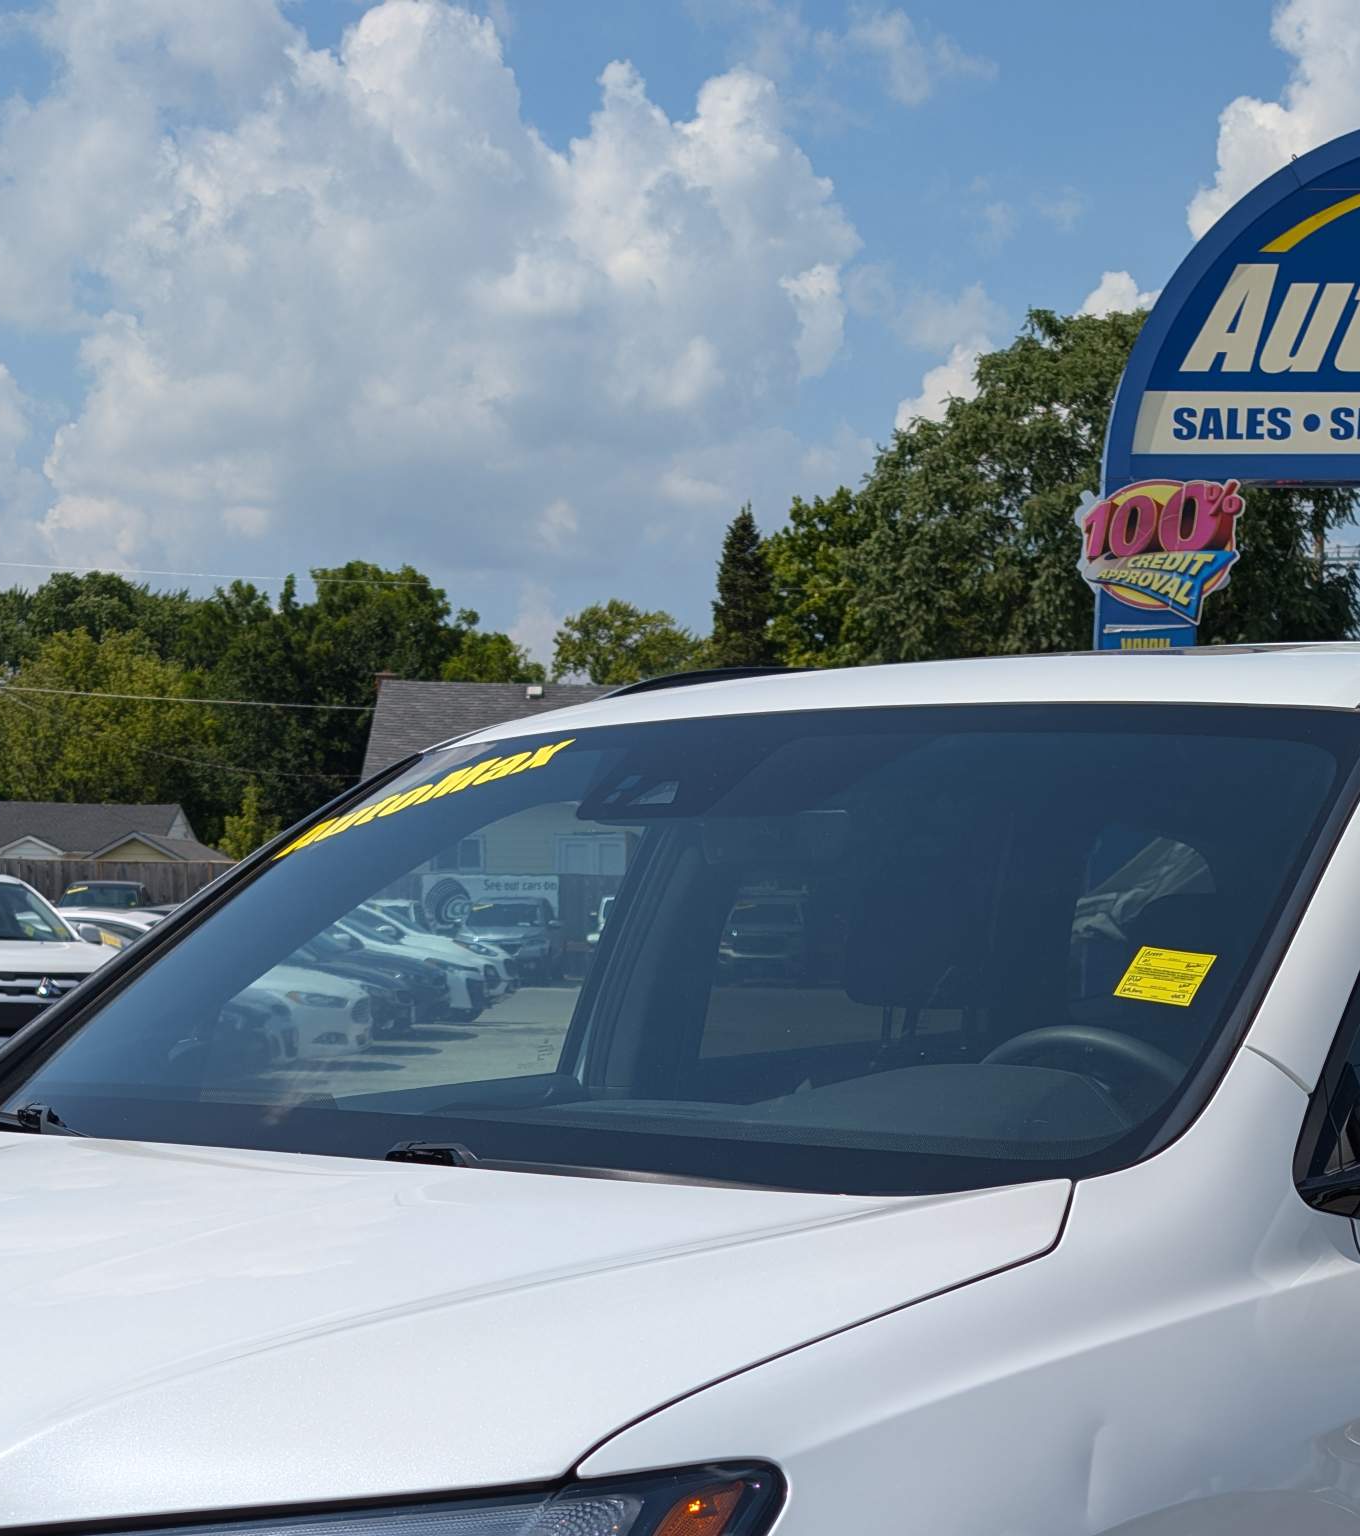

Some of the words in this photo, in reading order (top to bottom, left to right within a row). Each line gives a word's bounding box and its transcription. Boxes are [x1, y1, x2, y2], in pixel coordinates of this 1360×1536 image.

[1173, 406, 1292, 441] SALES
[1085, 479, 1244, 560] 100%
[1127, 552, 1215, 576] CREDIT
[1097, 569, 1193, 606] APPROVAL
[273, 738, 576, 860] AutoMax
